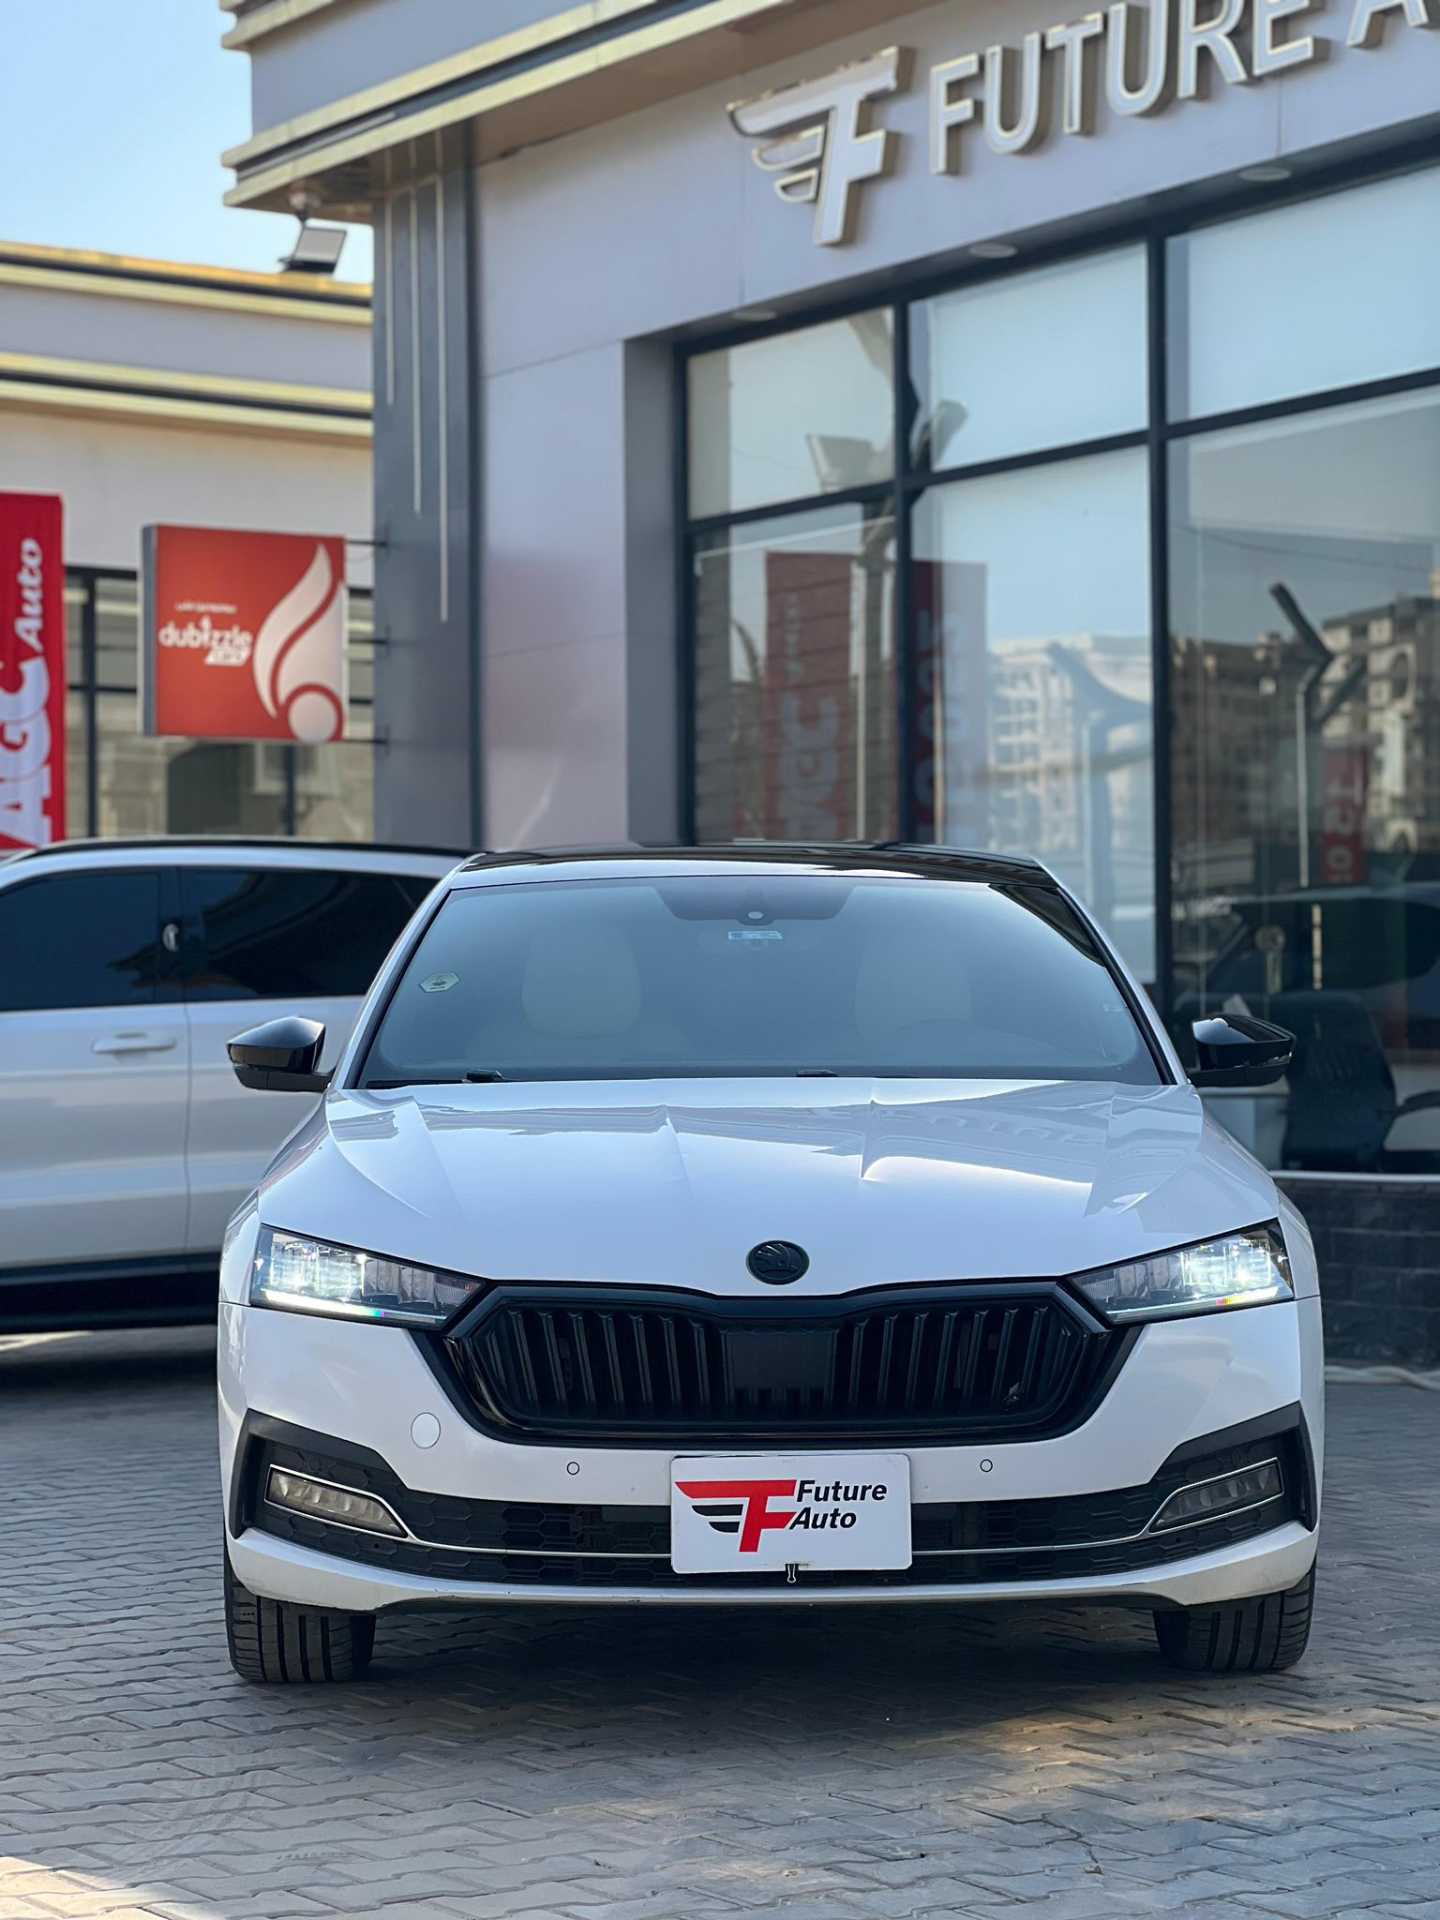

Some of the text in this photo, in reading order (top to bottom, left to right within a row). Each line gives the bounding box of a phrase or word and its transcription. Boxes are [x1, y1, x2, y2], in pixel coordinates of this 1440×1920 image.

[930, 0, 1315, 174] FUTURE
[14, 538, 43, 653] Auto
[789, 1507, 857, 1530] Auto
[796, 1479, 888, 1503] Future
